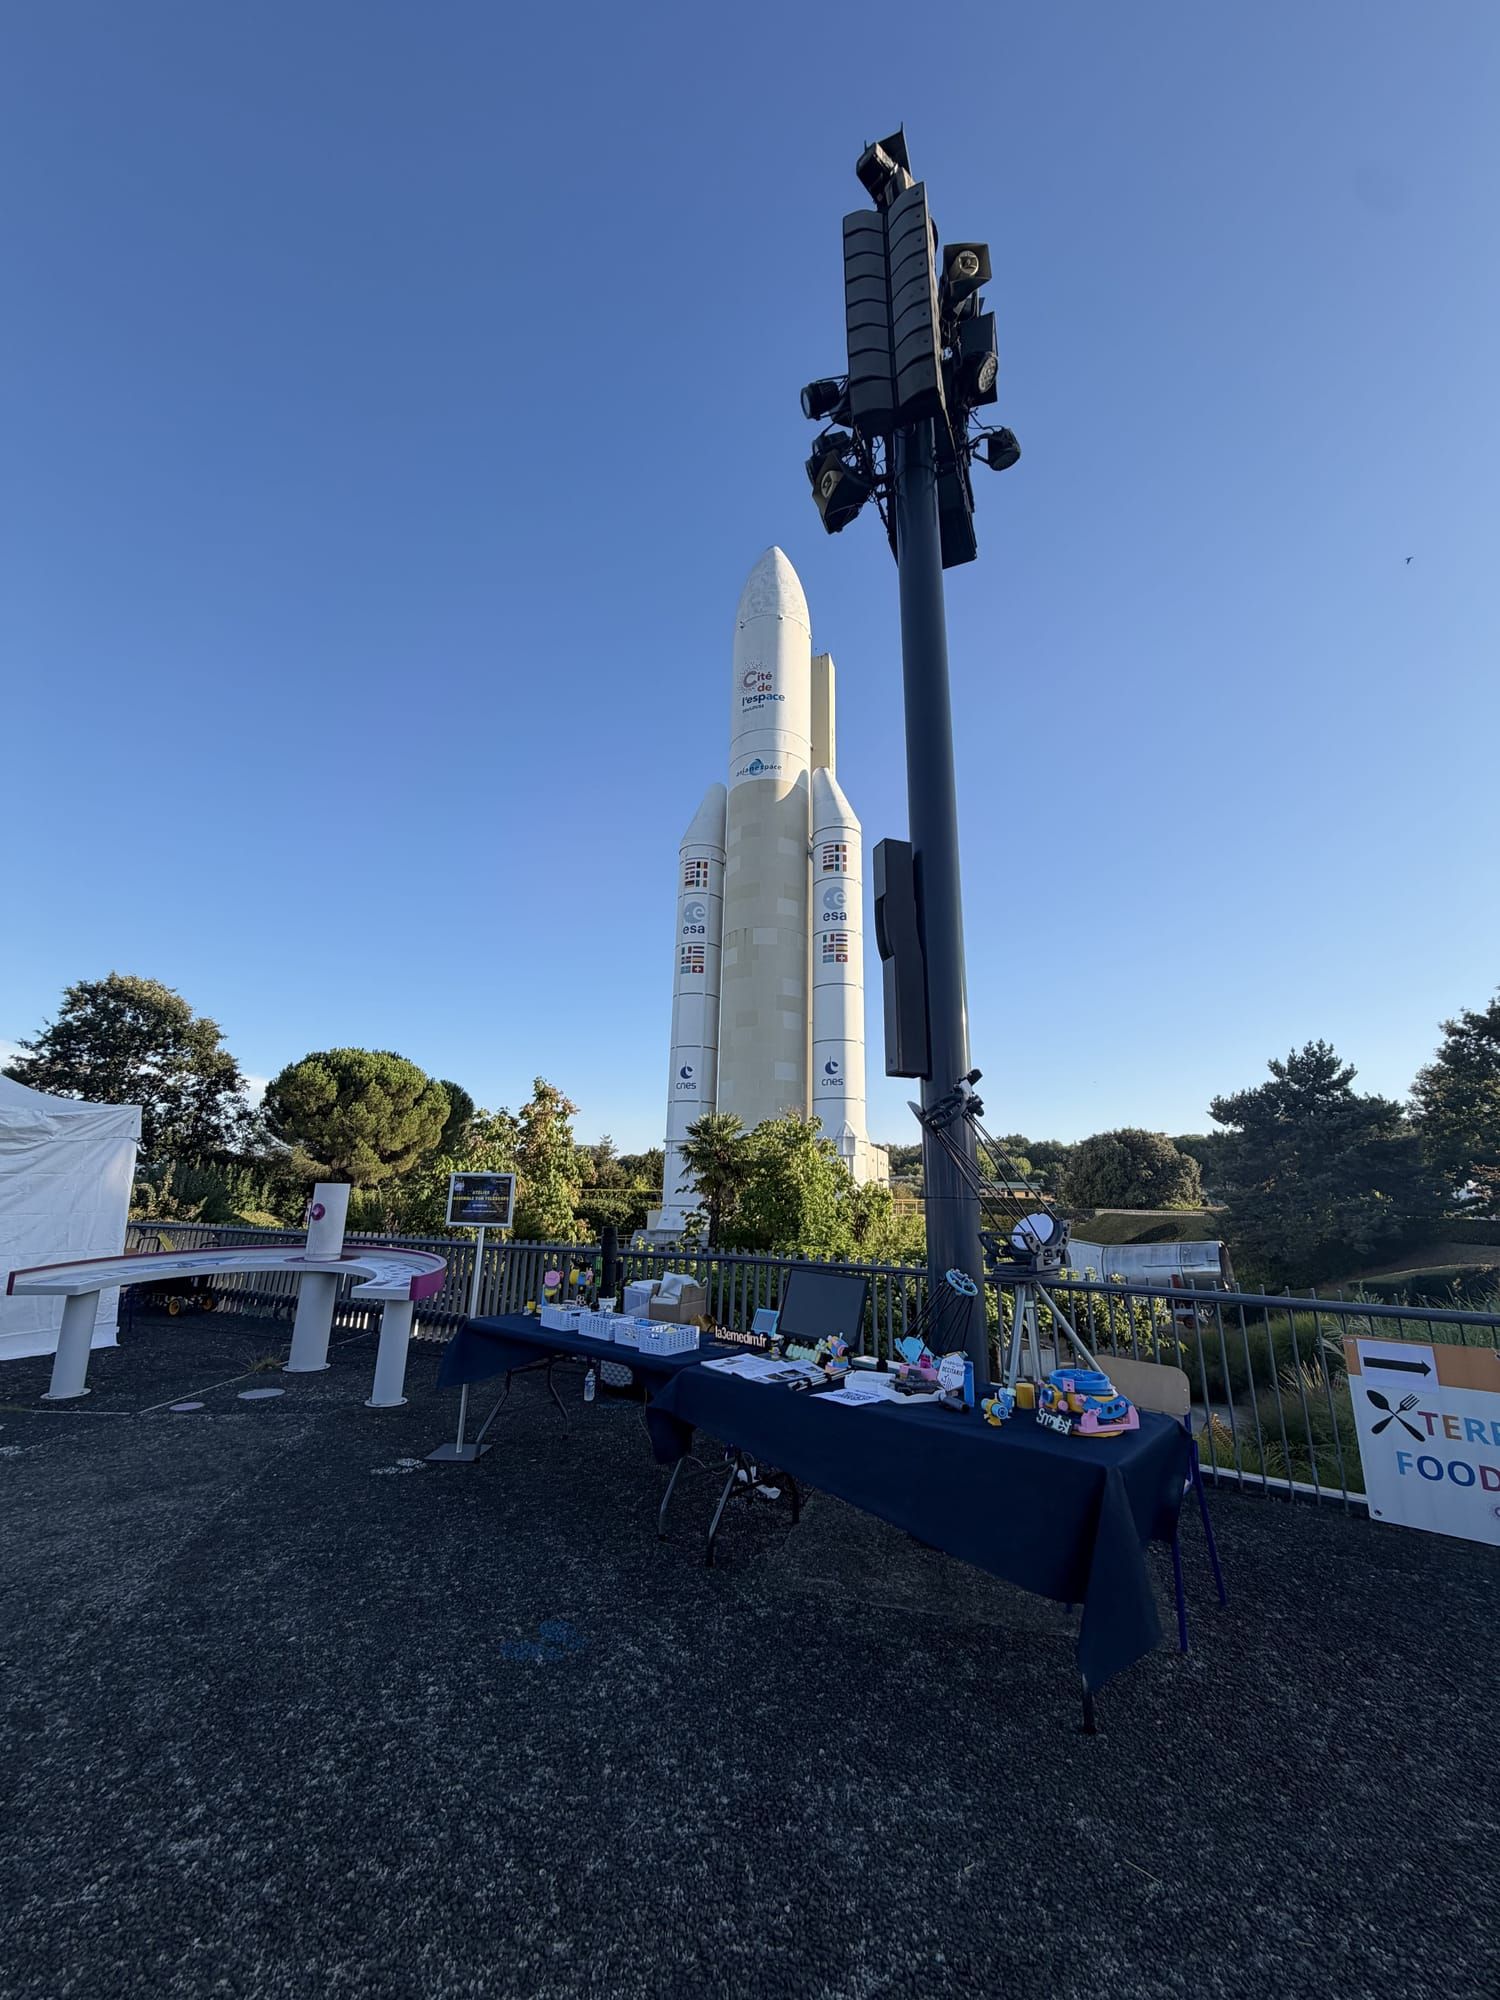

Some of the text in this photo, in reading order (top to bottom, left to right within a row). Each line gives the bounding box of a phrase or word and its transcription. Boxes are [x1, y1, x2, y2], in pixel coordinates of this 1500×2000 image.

[743, 670, 773, 688] Cité
[757, 682, 773, 692] de
[742, 693, 786, 706] l'espace
[823, 911, 848, 922] esa
[682, 925, 705, 935] esa
[675, 1082, 697, 1090] cnes
[821, 1078, 845, 1087] cnes
[715, 1325, 768, 1348] la3emedim.fr
[1396, 1450, 1500, 1492] FOOD
